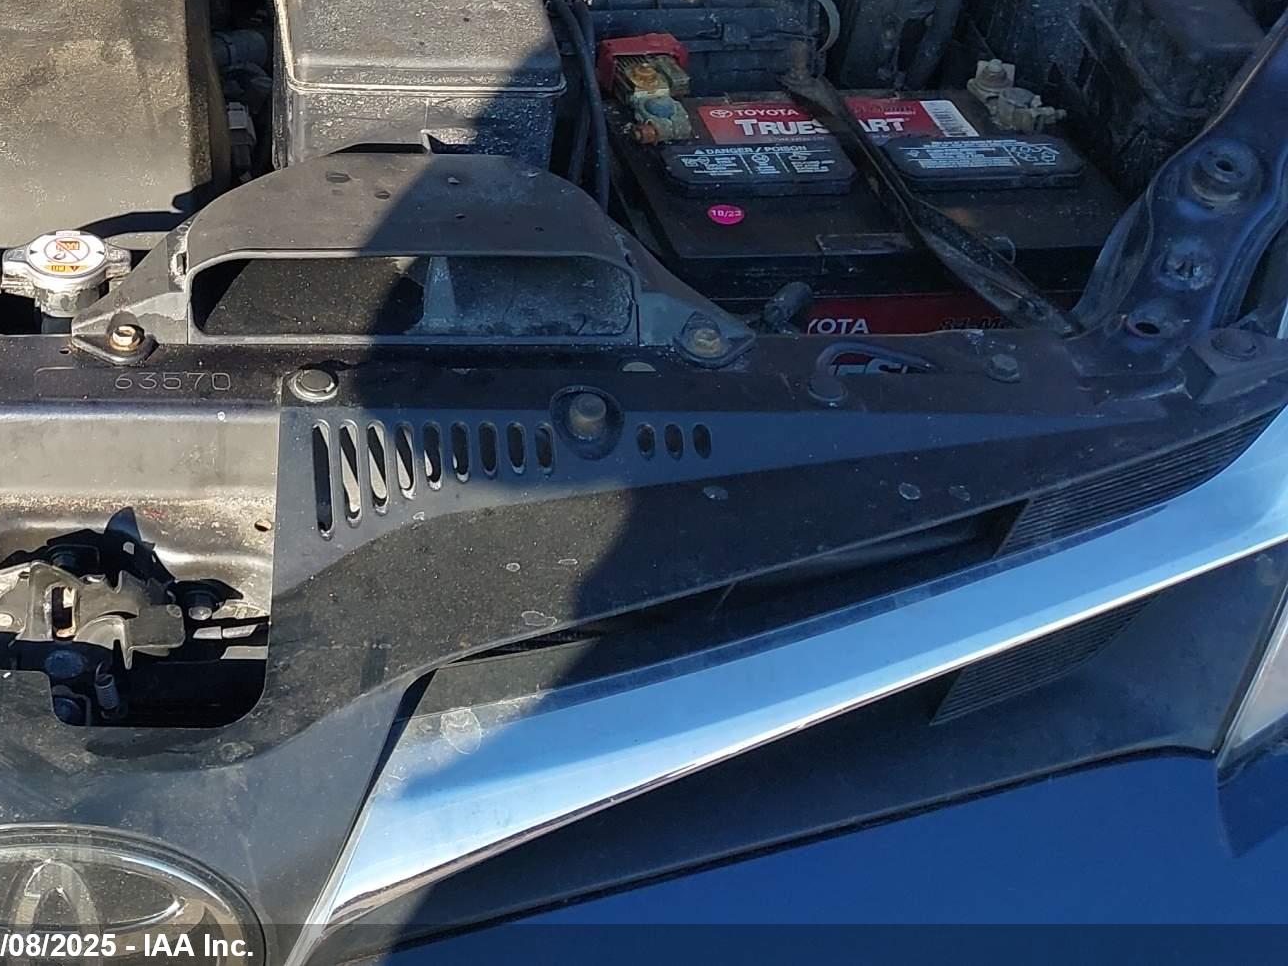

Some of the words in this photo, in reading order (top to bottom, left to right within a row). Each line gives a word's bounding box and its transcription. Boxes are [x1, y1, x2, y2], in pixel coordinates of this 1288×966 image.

[735, 108, 800, 117] TOYOTA
[734, 118, 906, 136] TRUESRT
[114, 371, 231, 391] 63570
